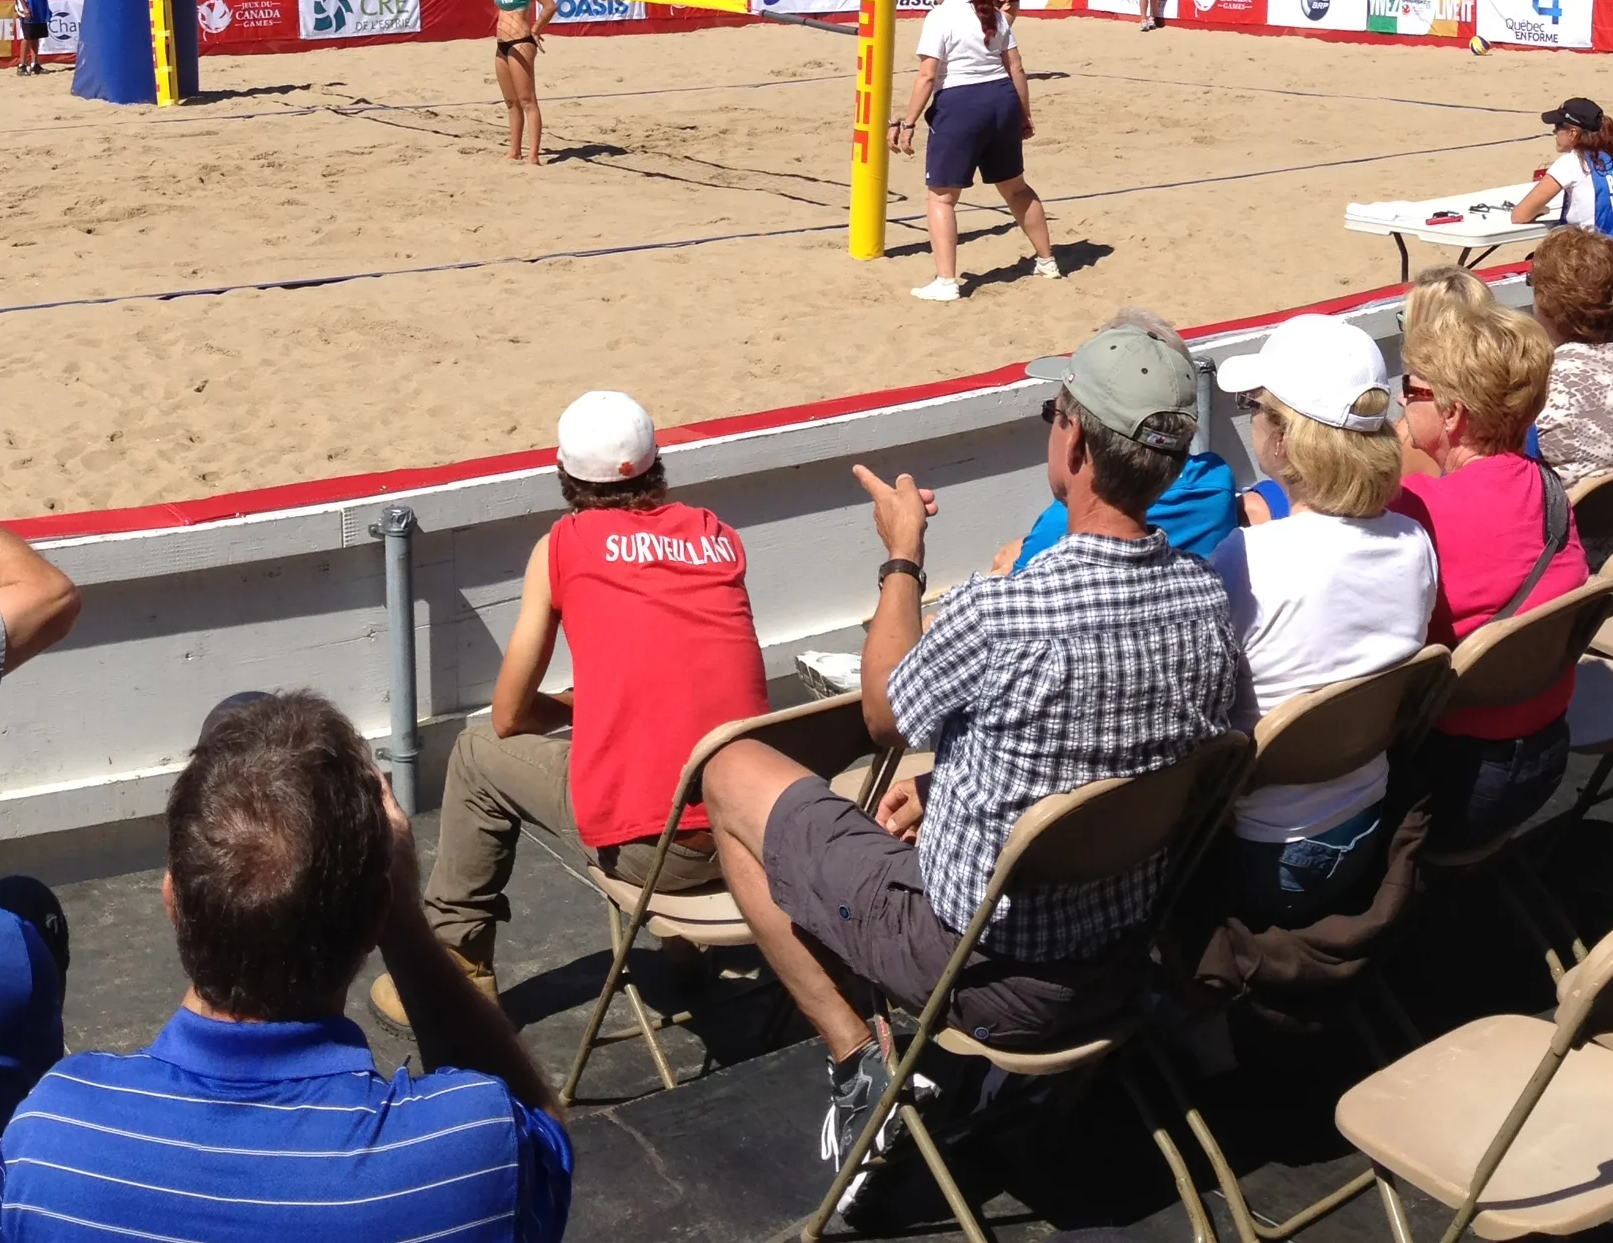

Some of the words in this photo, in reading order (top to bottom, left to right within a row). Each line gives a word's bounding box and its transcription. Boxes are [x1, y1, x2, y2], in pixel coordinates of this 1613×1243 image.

[1311, 1, 1331, 10] BRP
[235, 9, 281, 21] CANADA
[243, 19, 274, 28] GAMES
[355, 21, 369, 32] DE
[370, 18, 411, 32] L'ESTRIE
[1505, 17, 1545, 33] Québec
[1515, 31, 1527, 42] EN
[1527, 32, 1559, 44] FORME
